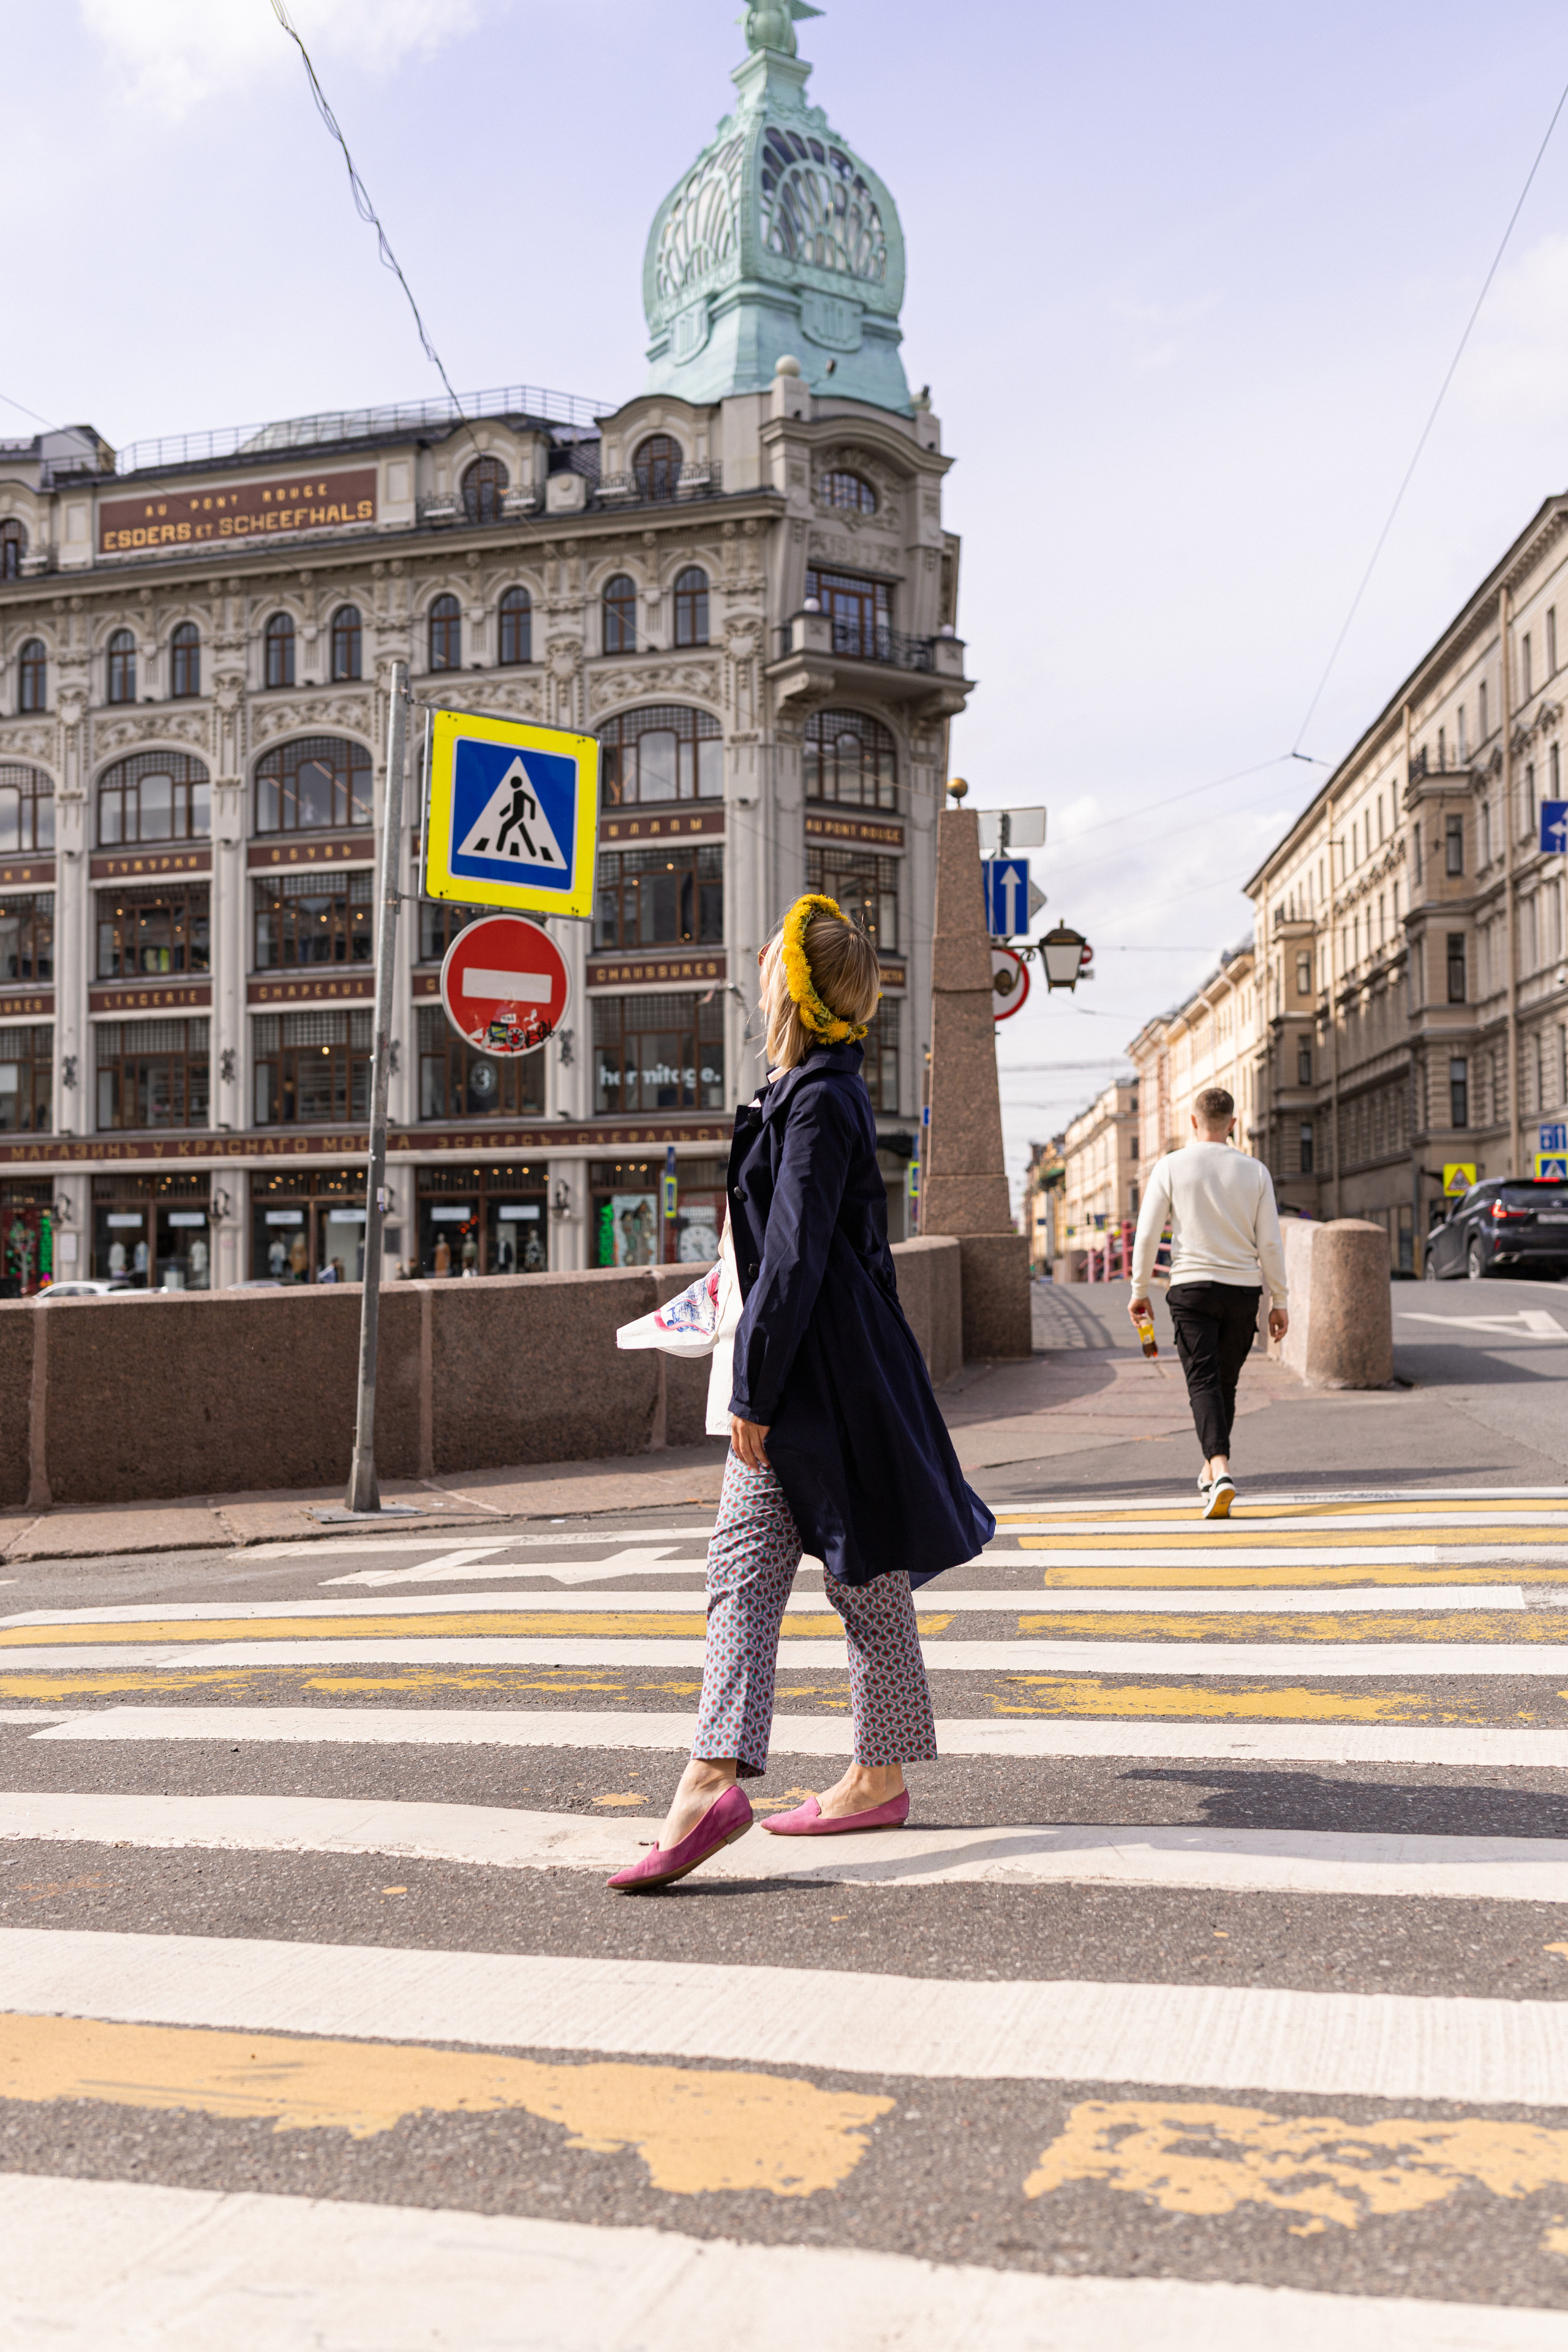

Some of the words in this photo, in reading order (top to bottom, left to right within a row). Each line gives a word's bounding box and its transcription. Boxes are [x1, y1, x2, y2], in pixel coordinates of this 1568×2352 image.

[145, 503, 167, 518] AU
[190, 494, 238, 511] PONT
[262, 483, 328, 503] ROUGE
[103, 522, 191, 551] ESDERS
[195, 524, 213, 538] ET
[218, 500, 373, 537] SCHEEFHALS
[608, 817, 703, 837] ШЛЯПЫ
[805, 818, 823, 833] AU
[824, 821, 856, 836] PONT
[860, 825, 900, 843] ROUGE
[271, 844, 352, 862] ОБУВЬ
[107, 856, 198, 874] ТУЖУРКИ
[596, 962, 717, 982] CHAUSSURES
[103, 989, 197, 1008] LINGERIE
[258, 981, 364, 1000] CHAPEAUX
[0, 998, 43, 1013] URES
[10, 1142, 139, 1161] МАГАЗИНЪ
[177, 1137, 308, 1156] КРАСНАГО
